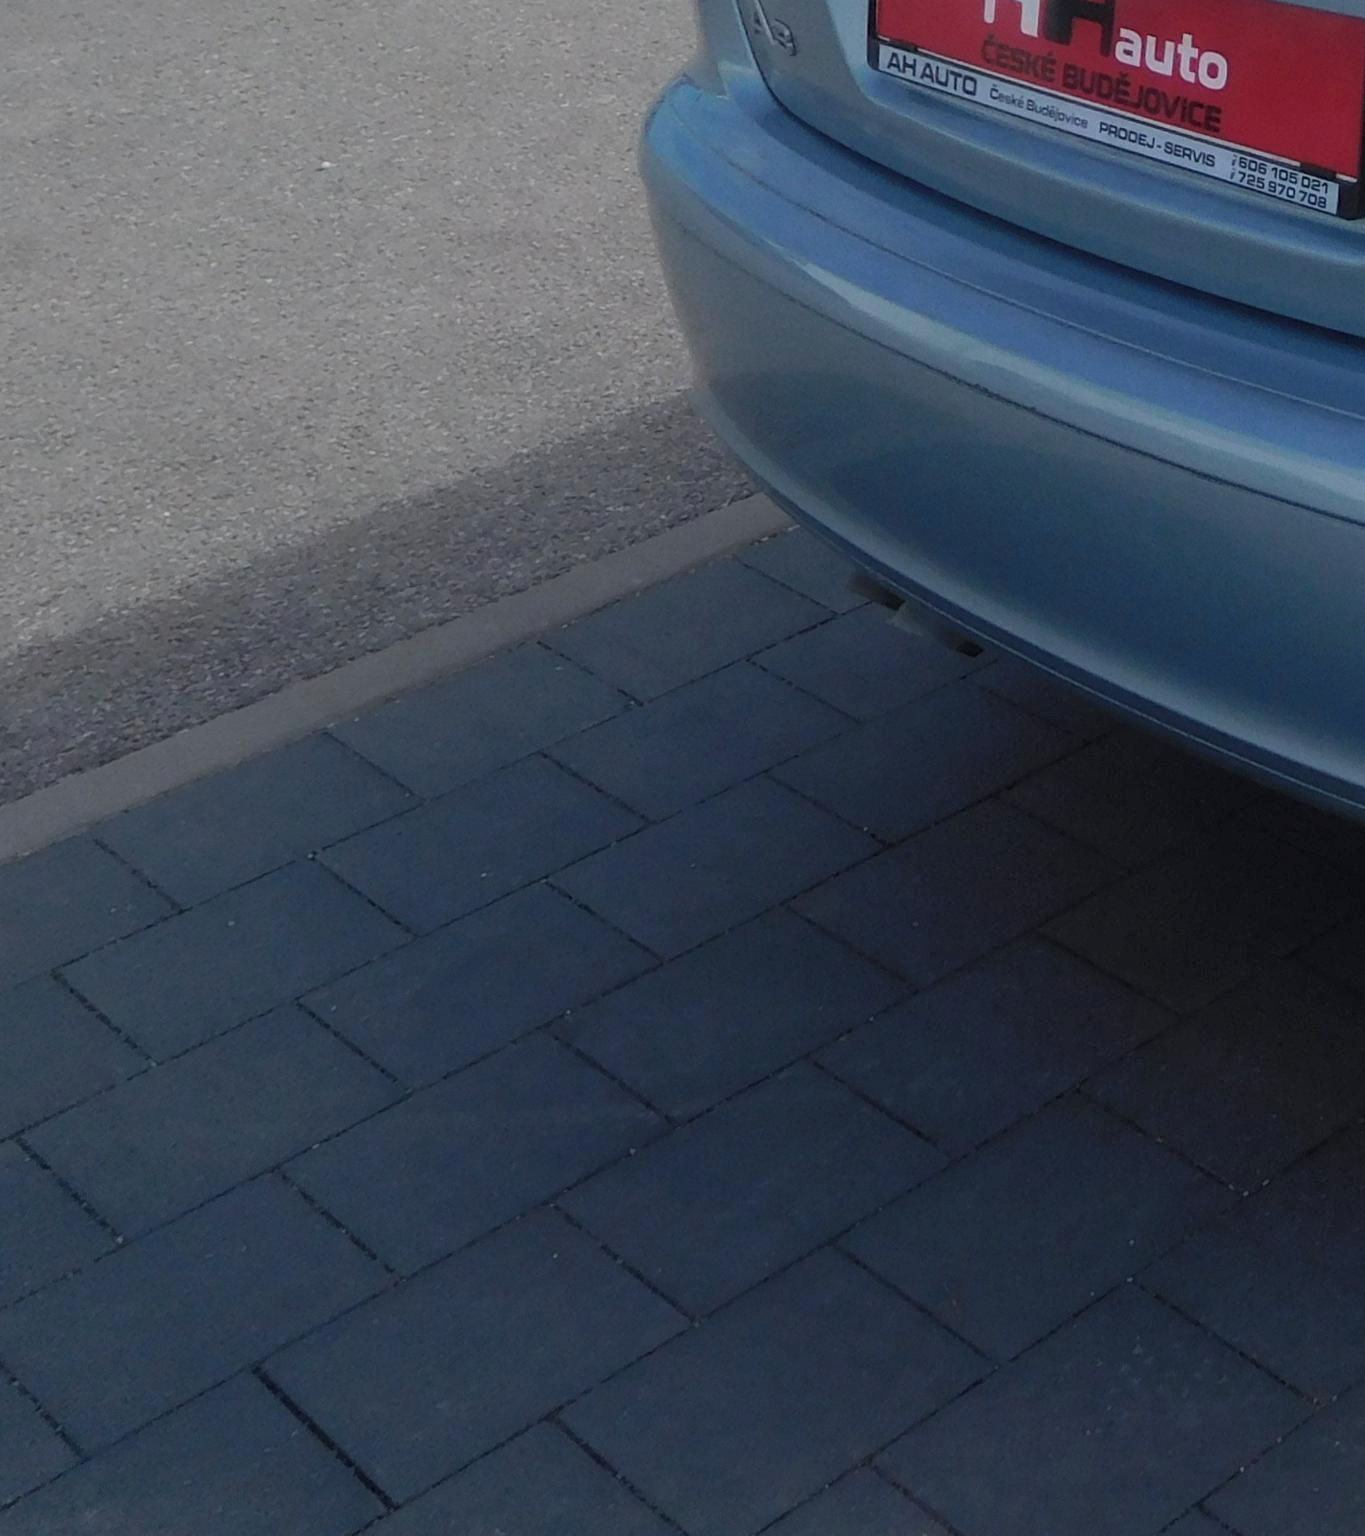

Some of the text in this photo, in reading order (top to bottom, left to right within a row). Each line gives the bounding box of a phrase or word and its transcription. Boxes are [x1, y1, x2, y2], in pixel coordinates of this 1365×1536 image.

[887, 51, 917, 78] AH
[919, 67, 978, 97] AUTO
[989, 83, 1024, 110] České
[1026, 98, 1089, 129] Budějovice
[981, 34, 1222, 134] ČESKÉ BUDĚJOVICE
[1115, 28, 1228, 90] auto
[1238, 171, 1327, 209] 725 970 708
[1271, 166, 1298, 185] 105
[1300, 177, 1329, 195] 021
